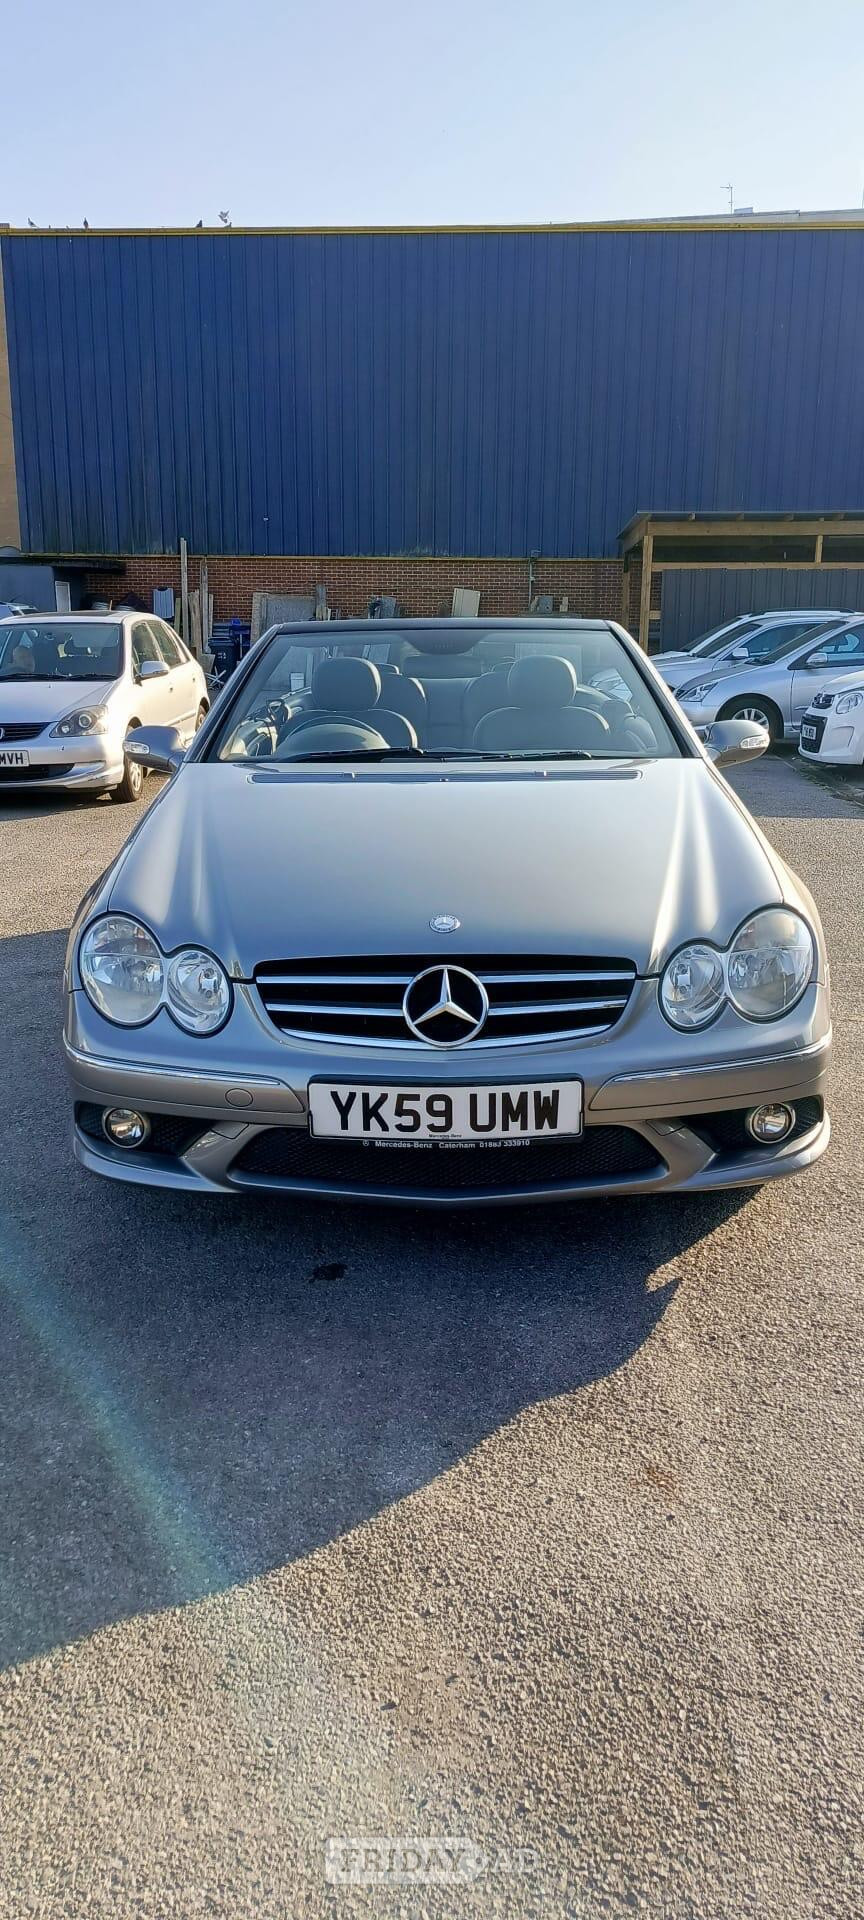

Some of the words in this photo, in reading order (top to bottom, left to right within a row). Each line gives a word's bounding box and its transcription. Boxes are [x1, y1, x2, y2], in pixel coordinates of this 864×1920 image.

[0, 752, 24, 765] MVH
[330, 1090, 453, 1133] YK59
[469, 1089, 560, 1133] UMW
[374, 1140, 433, 1149] Mercedes-Benz
[438, 1141, 476, 1149] Caterham
